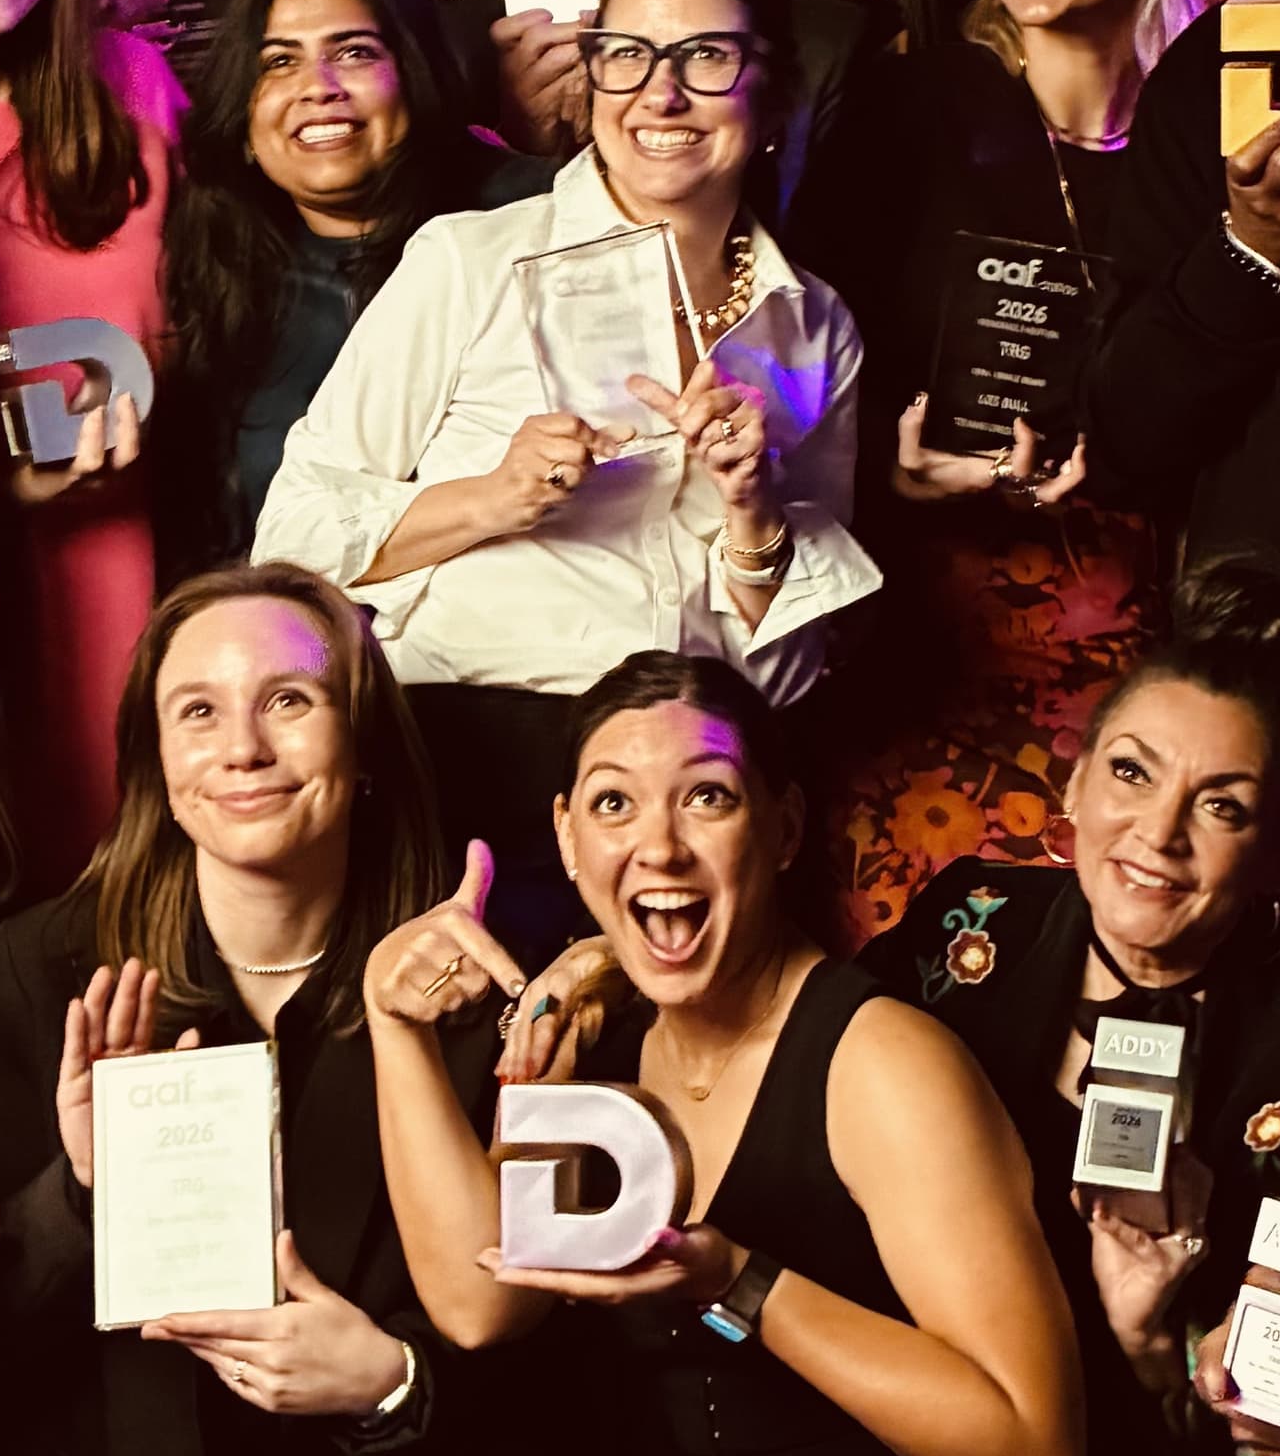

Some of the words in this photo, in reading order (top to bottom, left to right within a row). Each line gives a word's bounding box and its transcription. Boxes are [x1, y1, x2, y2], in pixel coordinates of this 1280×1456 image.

[977, 258, 1043, 288] aaf
[995, 298, 1049, 324] 2026
[1104, 1032, 1171, 1058] ADDY
[158, 1123, 215, 1147] 2026
